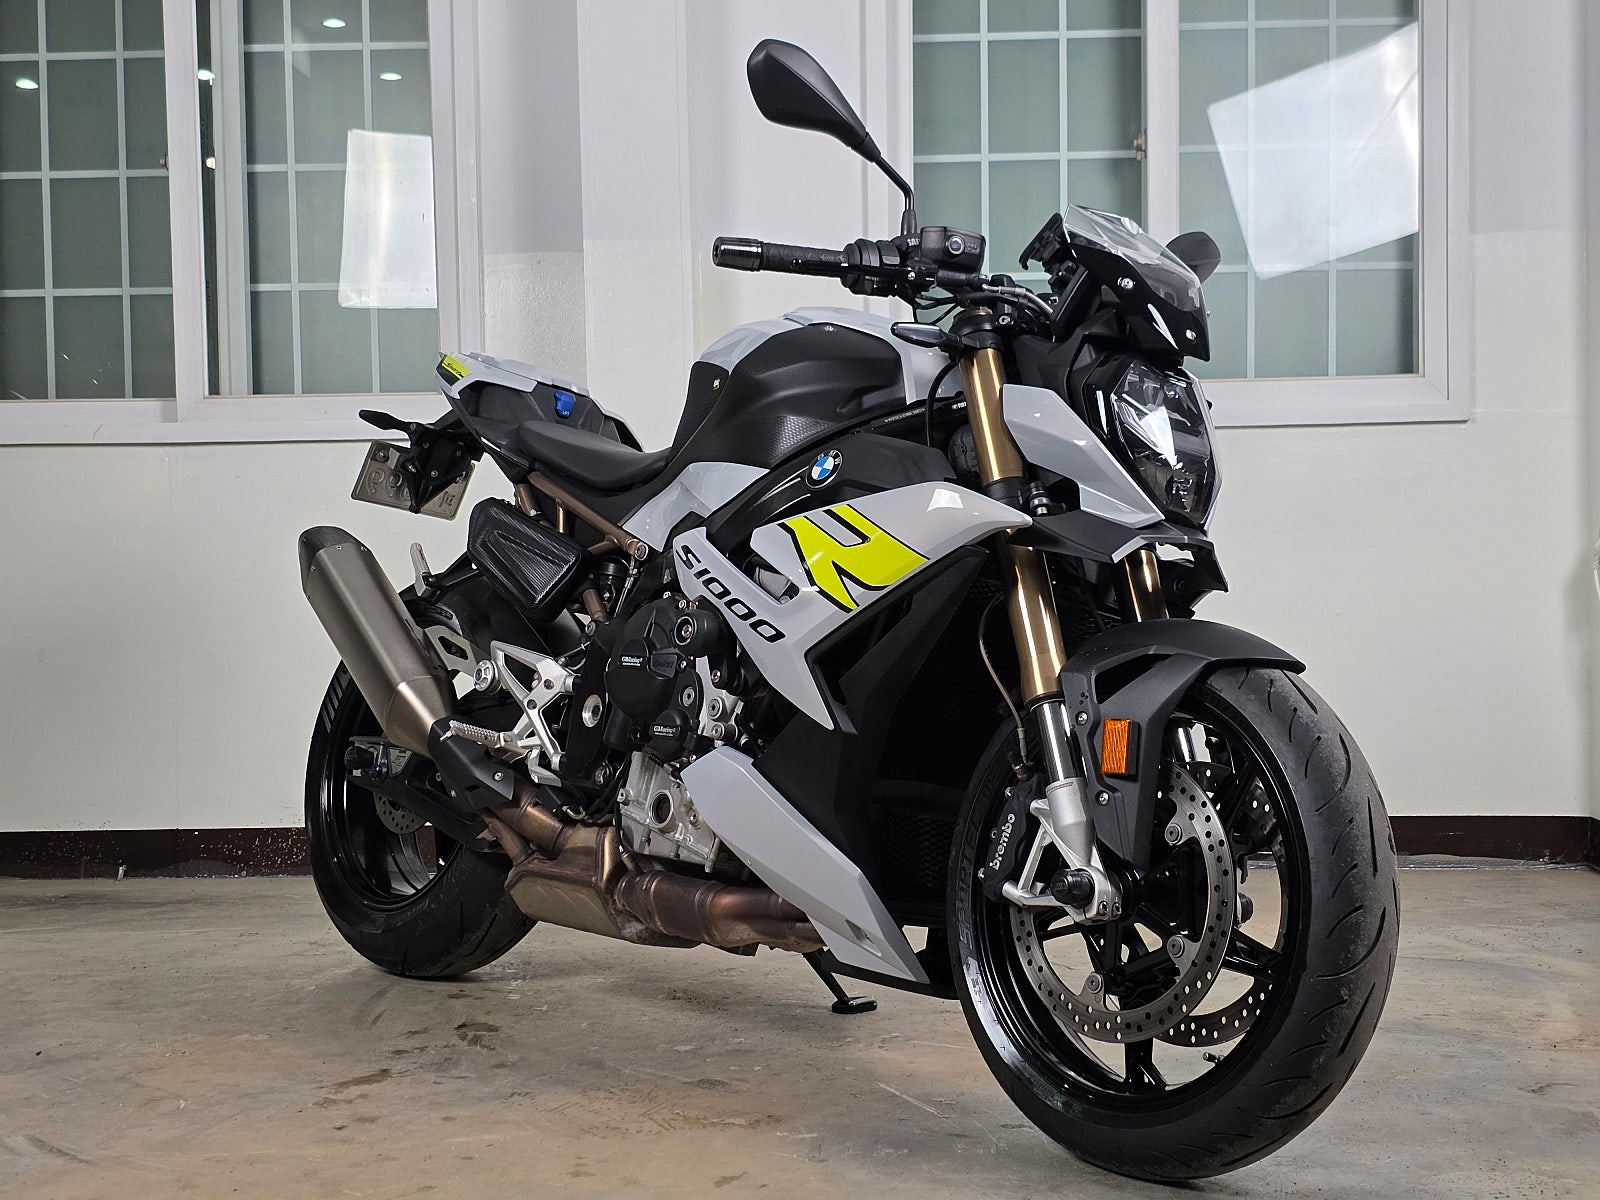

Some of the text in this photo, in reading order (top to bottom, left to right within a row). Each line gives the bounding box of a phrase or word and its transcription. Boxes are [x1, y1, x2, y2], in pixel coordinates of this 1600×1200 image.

[676, 545, 786, 643] S1000
[777, 504, 930, 613] R
[989, 813, 1016, 870] brembo
